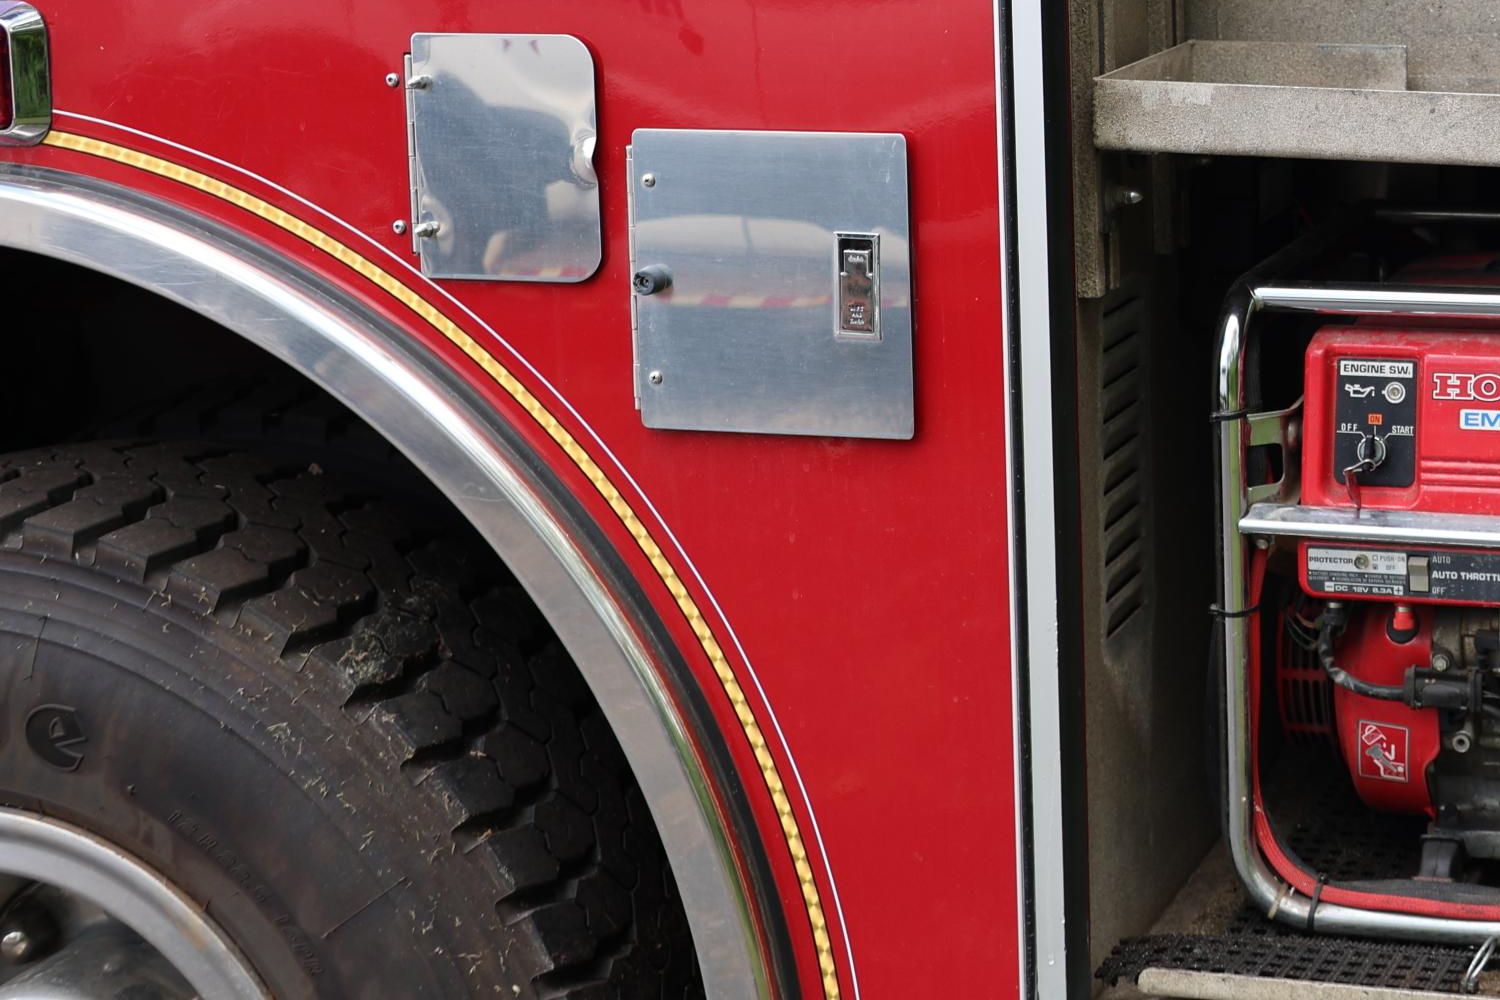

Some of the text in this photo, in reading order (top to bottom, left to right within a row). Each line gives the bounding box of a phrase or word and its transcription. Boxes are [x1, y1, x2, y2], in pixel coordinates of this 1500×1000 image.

[1344, 364, 1386, 374] ENGINE
[1341, 423, 1358, 431] OFF
[1392, 425, 1414, 434] START
[1309, 556, 1353, 564] PROTECTOR
[1432, 556, 1450, 564] AUTO
[1431, 571, 1458, 580] AUTO
[1335, 584, 1348, 592] DC
[1432, 587, 1446, 595] OFF
